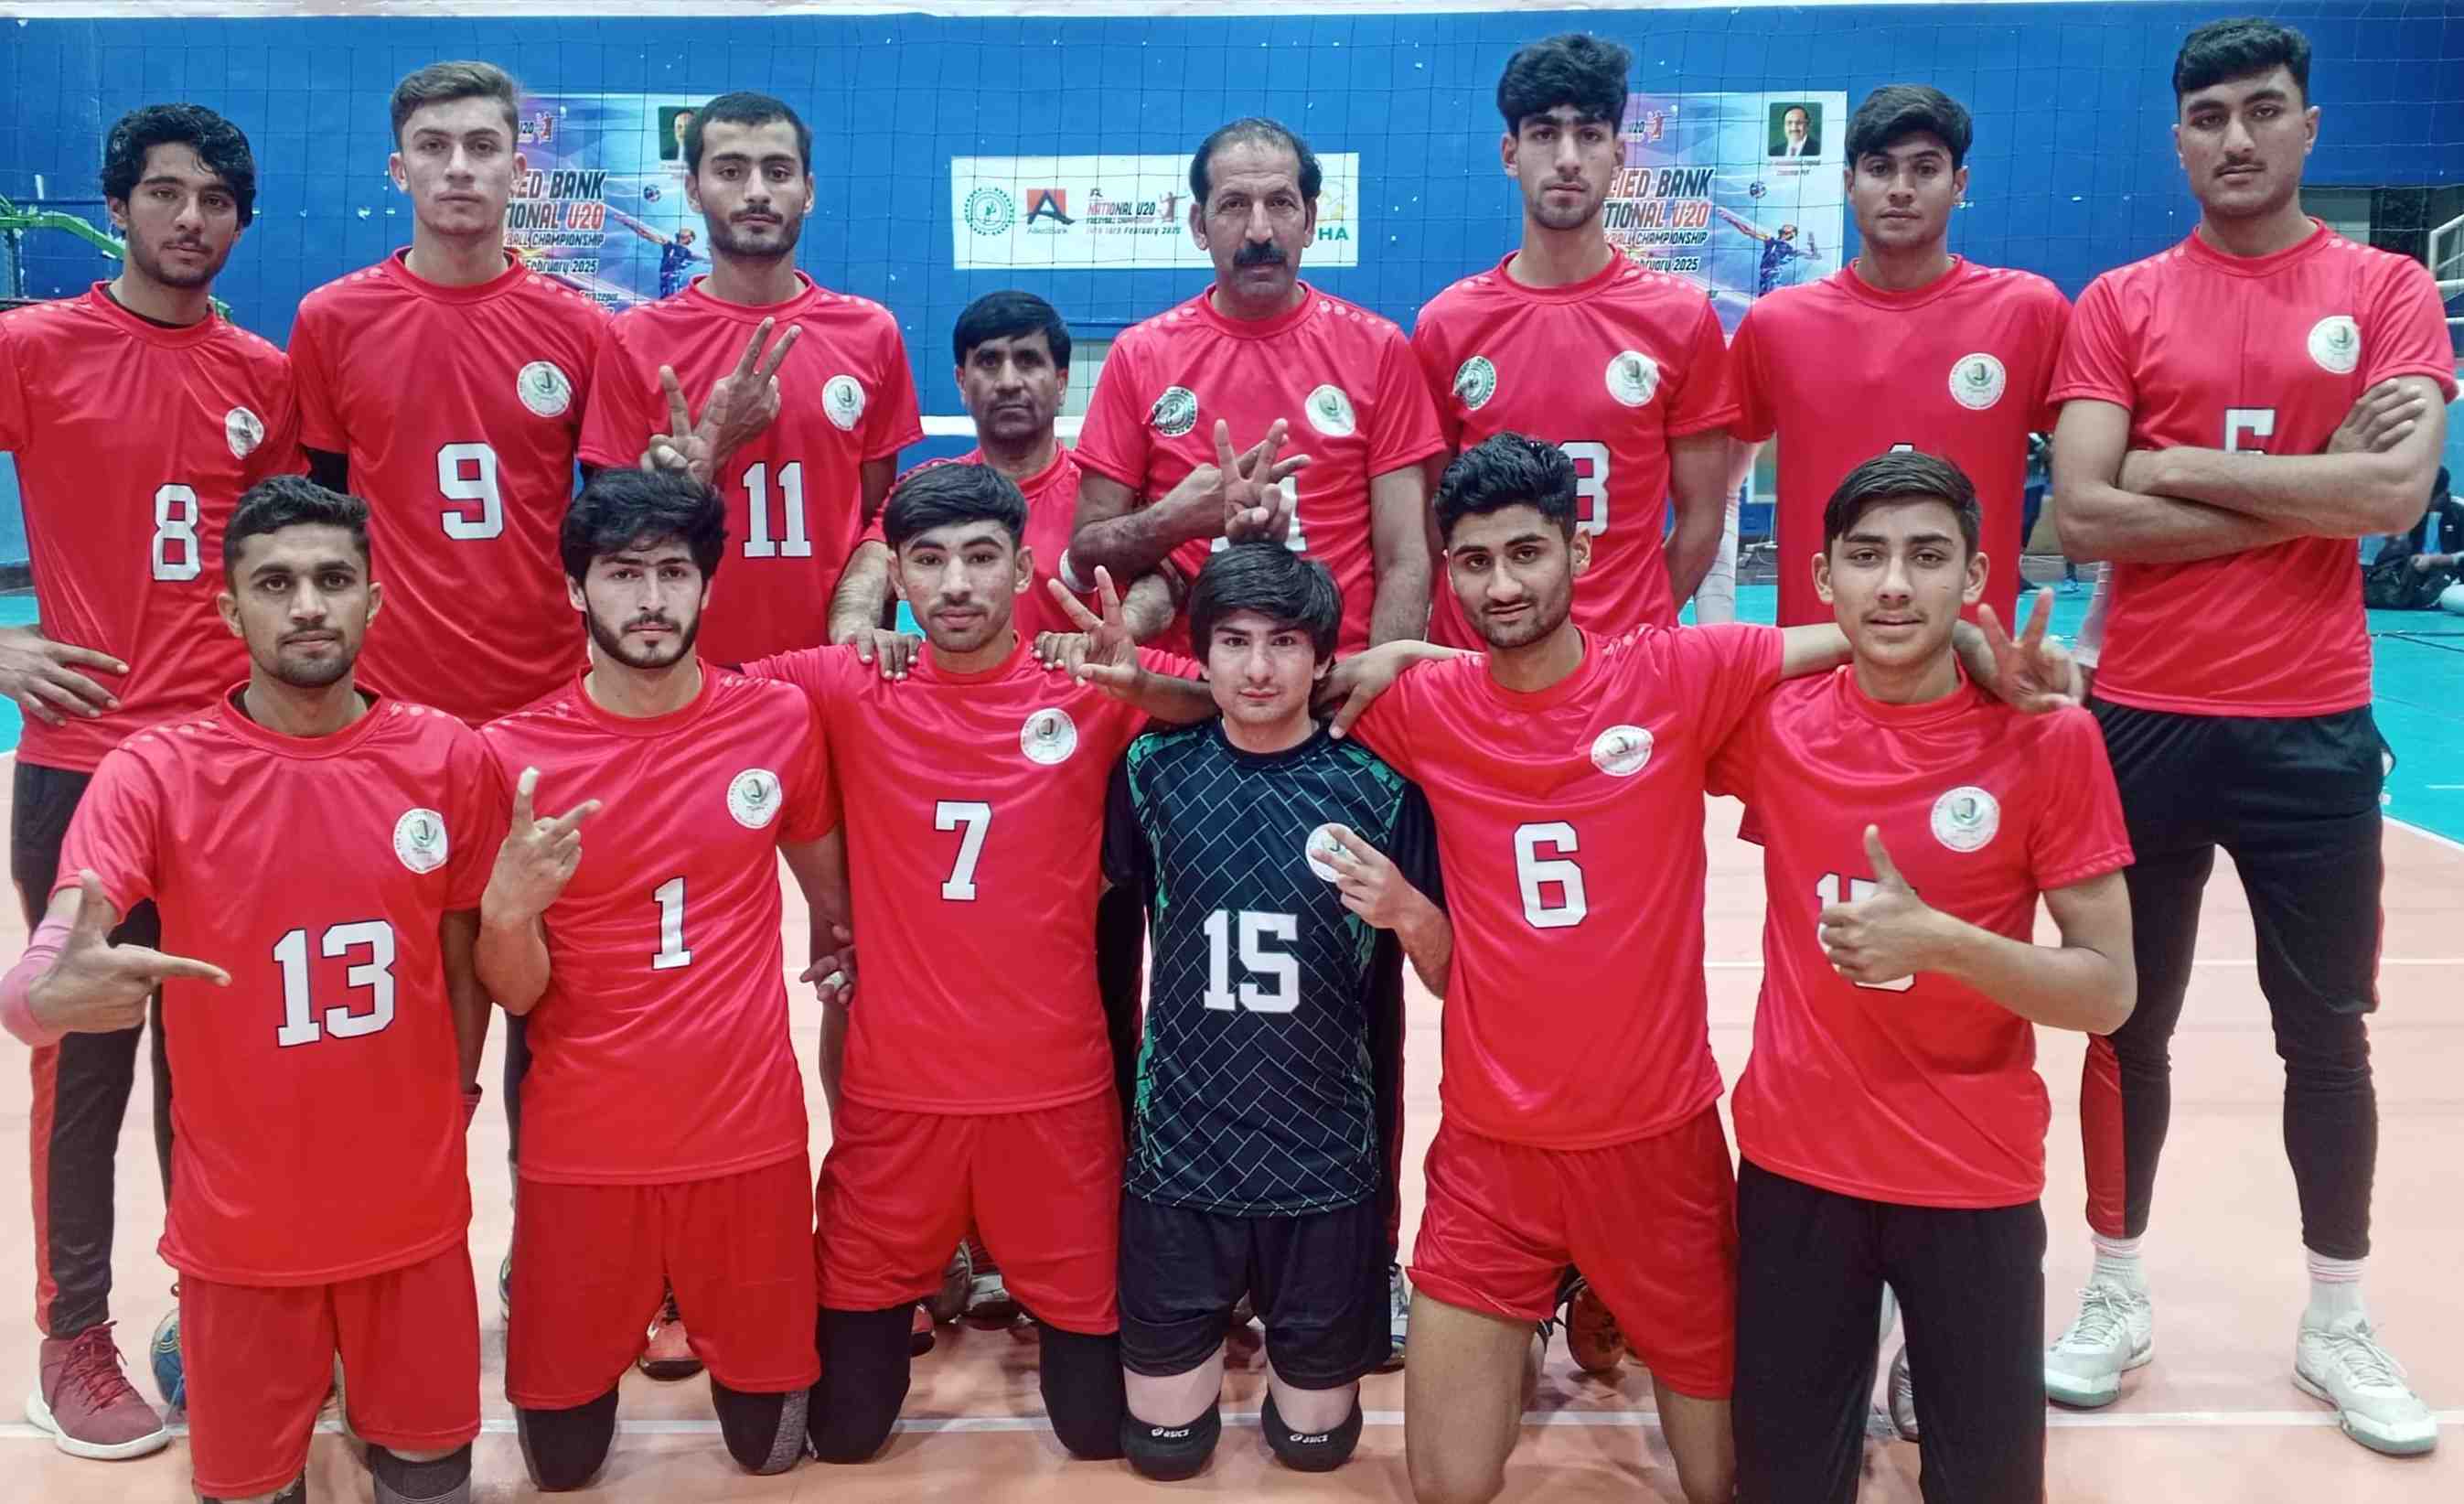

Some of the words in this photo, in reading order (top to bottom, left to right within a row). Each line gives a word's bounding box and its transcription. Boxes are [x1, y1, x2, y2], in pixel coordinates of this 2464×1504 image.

[549, 171, 606, 199] BANK
[1655, 168, 1715, 198] BANK
[567, 204, 604, 230] U20
[1136, 201, 1156, 216] U20
[1604, 201, 1666, 228] TIONAL
[1672, 202, 1710, 228] U20
[504, 233, 528, 246] BALL
[532, 233, 604, 246] CHAMPIONSHIP
[1635, 231, 1709, 245] CHAMPIONSHIP
[573, 259, 595, 273] 2025
[1673, 258, 1698, 271] 2025
[437, 443, 503, 540] 9
[742, 462, 812, 557] 11
[152, 483, 201, 581] 8
[934, 801, 991, 900] 7
[1513, 822, 1588, 928] 6
[652, 877, 691, 970] 1
[1203, 909, 1300, 1014] 15
[273, 920, 395, 1047] 13
